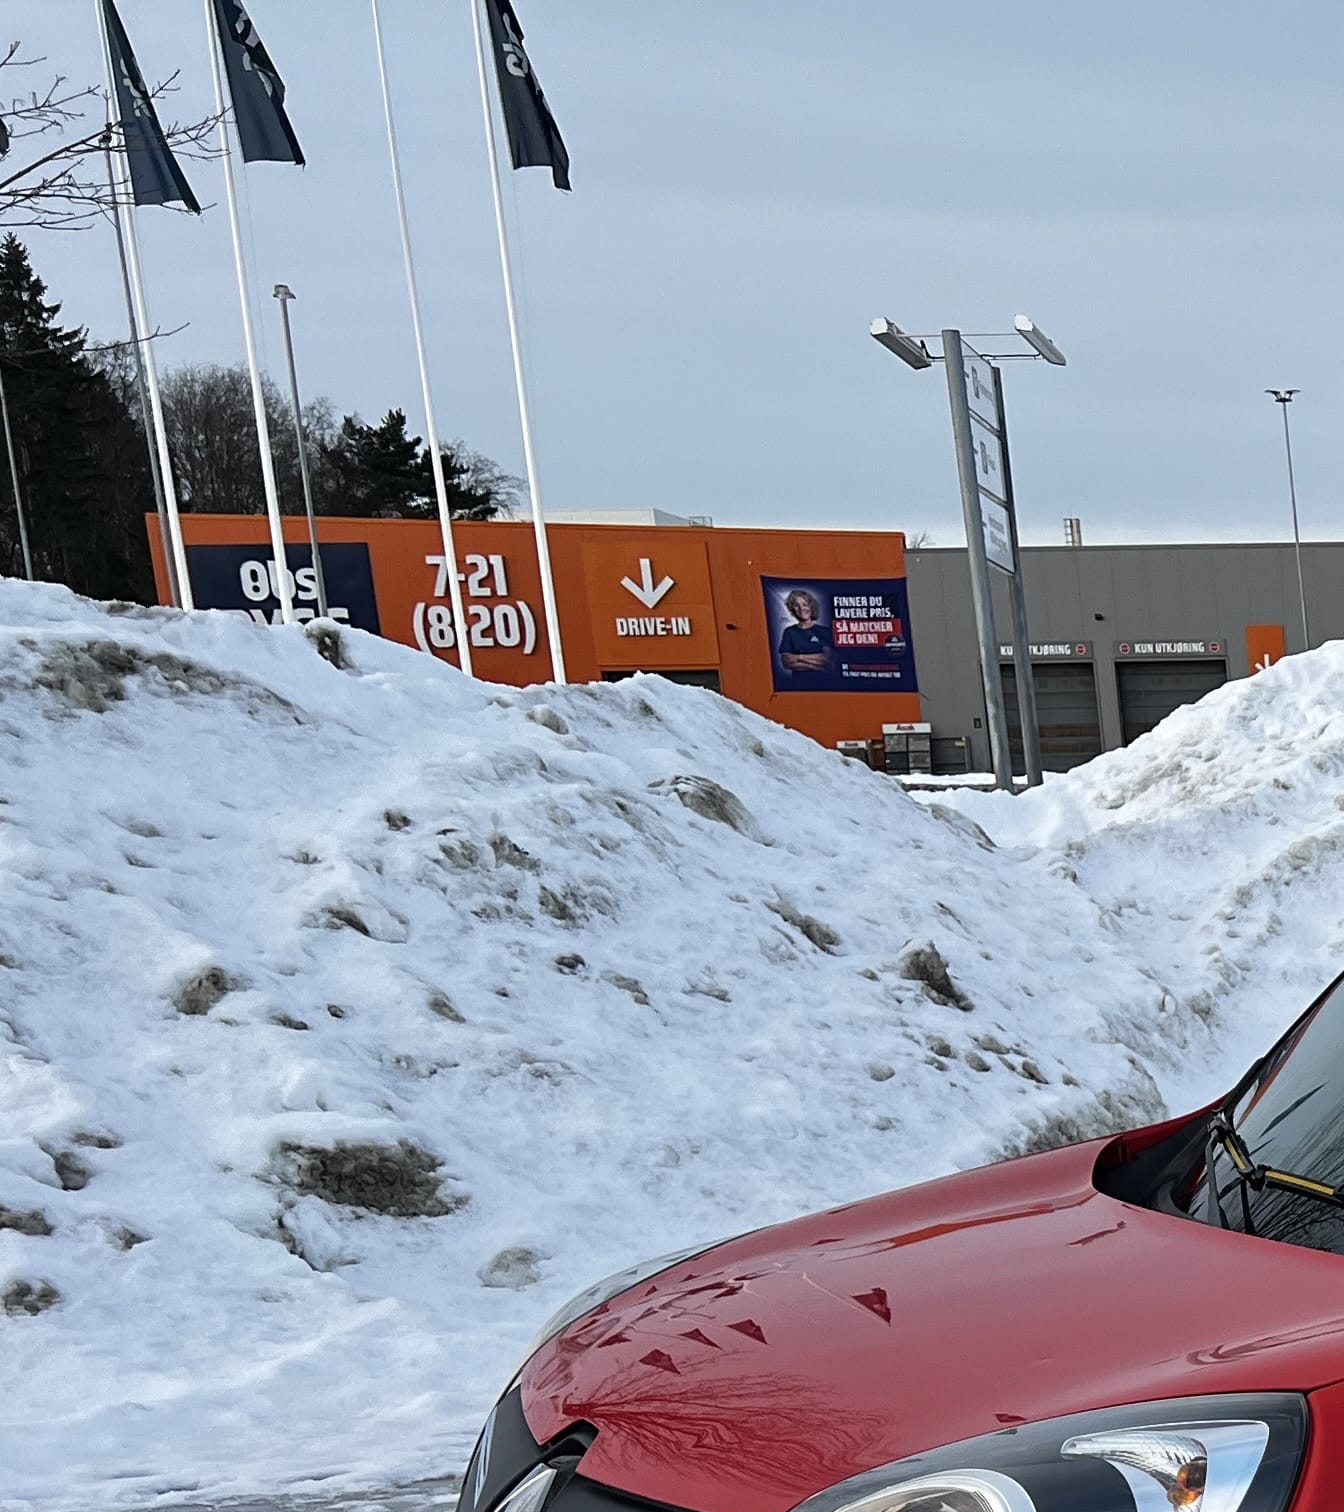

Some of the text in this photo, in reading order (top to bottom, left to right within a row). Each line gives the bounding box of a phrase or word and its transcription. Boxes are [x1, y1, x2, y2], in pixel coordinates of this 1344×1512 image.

[425, 555, 508, 597] 7-21
[833, 596, 883, 607] FINNER DU
[834, 607, 894, 618] LAVERE PRIS,
[615, 617, 691, 636] DRIVE-IN
[836, 620, 893, 632] SÅ MATCHER
[837, 633, 879, 644] JEG DEN!
[1000, 644, 1071, 656] KU TKJØRING
[1134, 642, 1204, 653] KUN UTKJØRING
